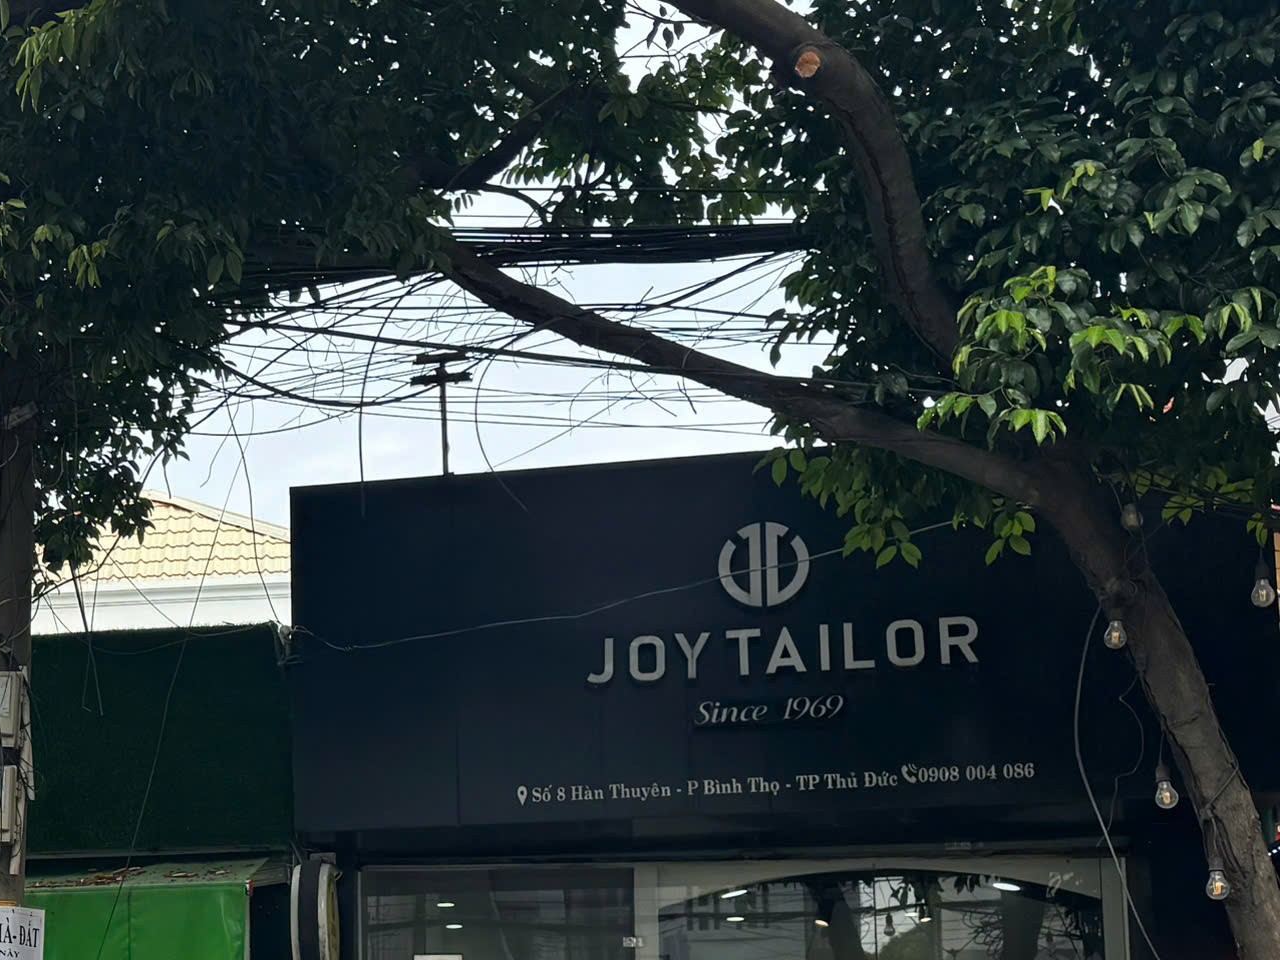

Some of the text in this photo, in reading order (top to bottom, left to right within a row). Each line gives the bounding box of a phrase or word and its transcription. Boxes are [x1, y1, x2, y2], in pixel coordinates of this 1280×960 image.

[694, 694, 844, 726] Since 1969
[532, 784, 552, 803] Số
[557, 786, 566, 801] 8
[571, 785, 604, 801] Hàn
[609, 783, 671, 801] Thuyên
[687, 780, 699, 796] P
[703, 778, 743, 795] Bình
[747, 777, 780, 796] Thọ
[796, 774, 820, 791] TP
[824, 772, 858, 789] Thủ
[863, 771, 898, 787] Đức
[918, 765, 960, 783] 0908
[965, 764, 997, 781] 004
[1002, 762, 1036, 779] 086
